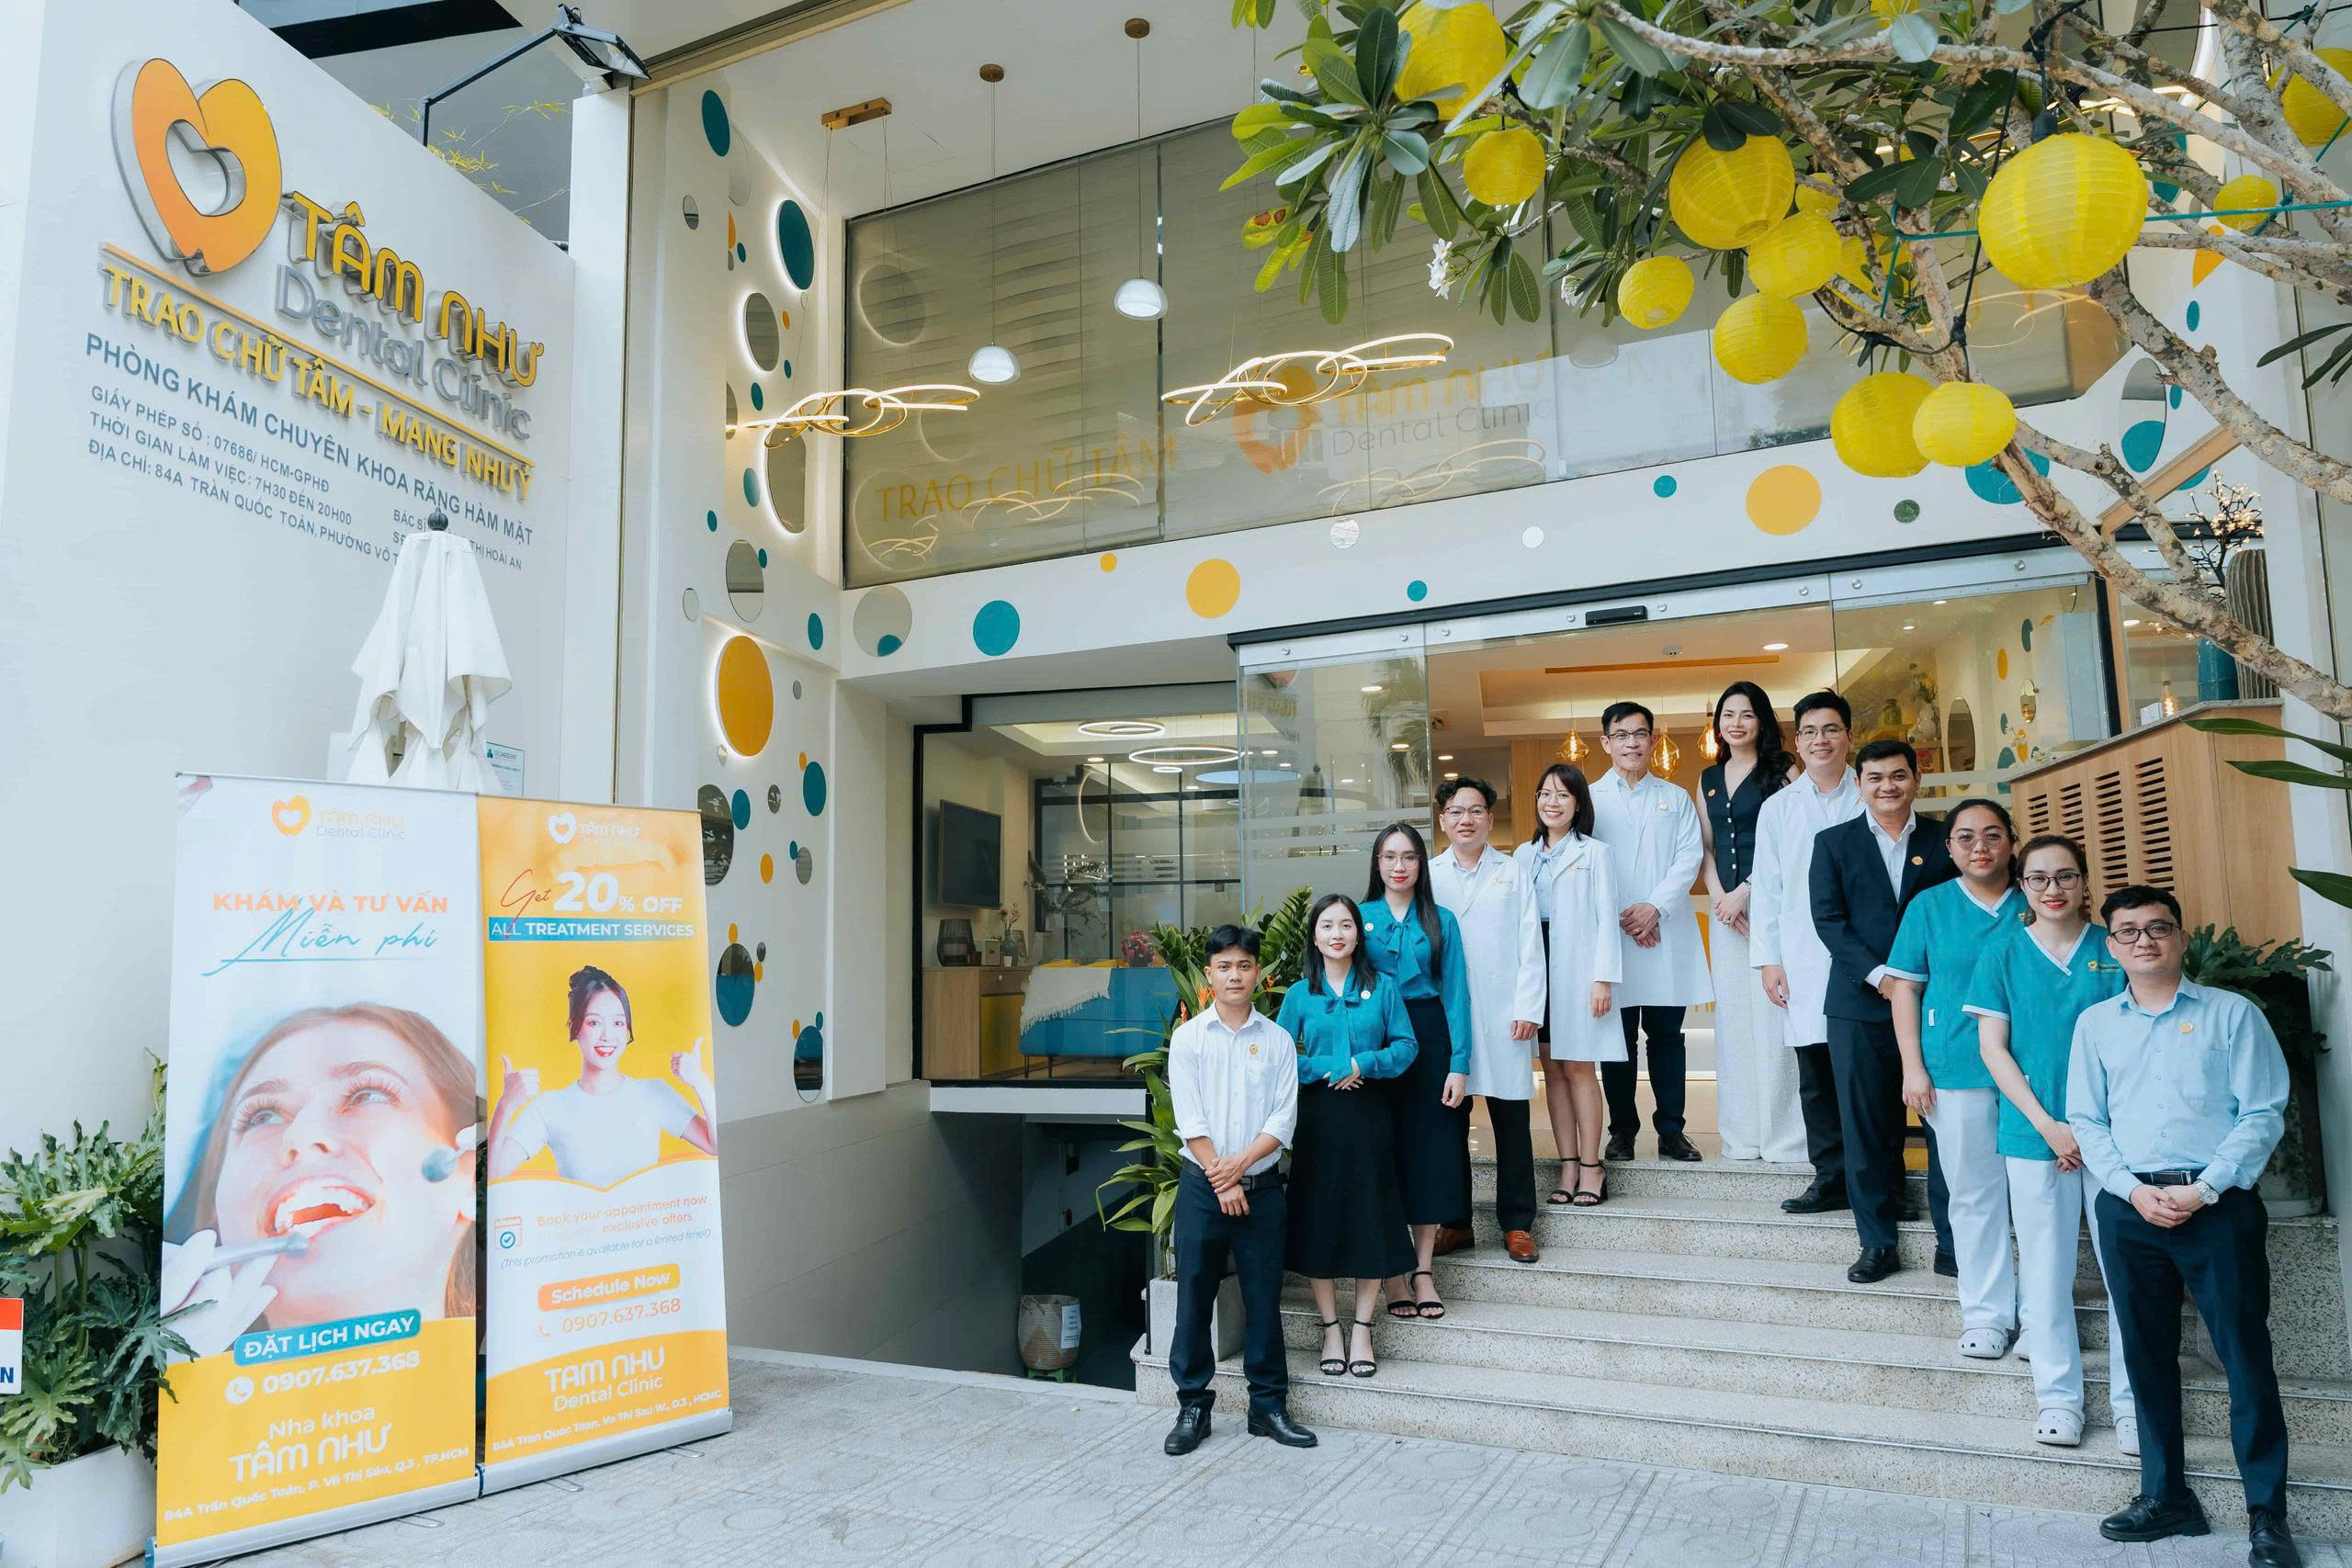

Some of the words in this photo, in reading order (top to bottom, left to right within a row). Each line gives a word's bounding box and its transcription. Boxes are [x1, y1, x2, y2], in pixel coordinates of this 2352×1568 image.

[100, 263, 204, 344] TRAO
[209, 321, 288, 382] CHỮ
[289, 356, 354, 418] TÂM
[378, 401, 458, 468] MANG
[277, 264, 428, 389] Dental
[432, 357, 532, 441] Clinic
[85, 332, 180, 393] PHÒNG
[187, 378, 258, 428] KHÁM
[264, 412, 349, 467] CHUYÊN
[356, 453, 409, 493] KHOA
[413, 478, 459, 513] RĂNG
[464, 501, 498, 531] HÀM
[503, 518, 533, 546] MẶT
[135, 401, 177, 431] PHÉP
[213, 434, 258, 464] 07686/
[260, 454, 330, 492] HCM-GPHĐ
[1332, 411, 1445, 457] Dental
[1455, 398, 1553, 433] Clinic
[89, 410, 130, 440] THỜI
[135, 429, 173, 457] GIAN
[178, 445, 209, 470] LÀM
[255, 476, 286, 500] 7H30
[317, 502, 352, 525] 20H00
[875, 474, 972, 523] TRAO
[987, 446, 1074, 504] CHỮ
[88, 438, 116, 461] ĐỊA
[154, 463, 183, 487] 84A
[374, 545, 390, 562] VÕ
[393, 508, 414, 527] BÁC
[509, 557, 522, 570] AN
[213, 889, 298, 911] KHÁM
[310, 890, 345, 911] VÀ
[353, 893, 390, 912] TƯ
[395, 890, 448, 912] VẤN
[501, 868, 552, 939] Get
[643, 896, 684, 913] OFF
[201, 897, 361, 976] Miễn
[491, 921, 522, 936] ALL
[525, 922, 620, 937] TREATMENT
[624, 923, 695, 937] SERVICES
[603, 1218, 659, 1234] exclusive
[662, 1212, 693, 1225] offers
[604, 1198, 681, 1219] appointment
[683, 1196, 707, 1206] now
[501, 1256, 522, 1270] (This
[524, 1249, 576, 1268] promotion
[577, 1248, 584, 1258] is
[585, 1241, 630, 1257] available
[631, 1237, 644, 1249] for
[654, 1232, 684, 1245] limited
[551, 1278, 630, 1304] Schedule
[633, 1272, 672, 1291] Now
[243, 1334, 293, 1359] ĐẶT
[299, 1325, 348, 1352] LỊCH
[354, 1315, 415, 1339] NGAY
[562, 1298, 681, 1333] 0907.637.368
[262, 1350, 421, 1394] 0907.637.368
[544, 1359, 605, 1393] TAM
[612, 1346, 665, 1379] NHU
[553, 1384, 612, 1412] Dental
[616, 1376, 663, 1397] Clinic
[268, 1418, 315, 1439] Nha
[322, 1405, 375, 1430] khoa
[516, 1434, 541, 1445] Tran
[543, 1427, 571, 1439] Quoc
[603, 1415, 616, 1425] Vo
[694, 1389, 722, 1403] HCMC
[229, 1439, 309, 1482] TÂM
[318, 1423, 393, 1465] NHƯ
[423, 1447, 469, 1465] TP.HCM
